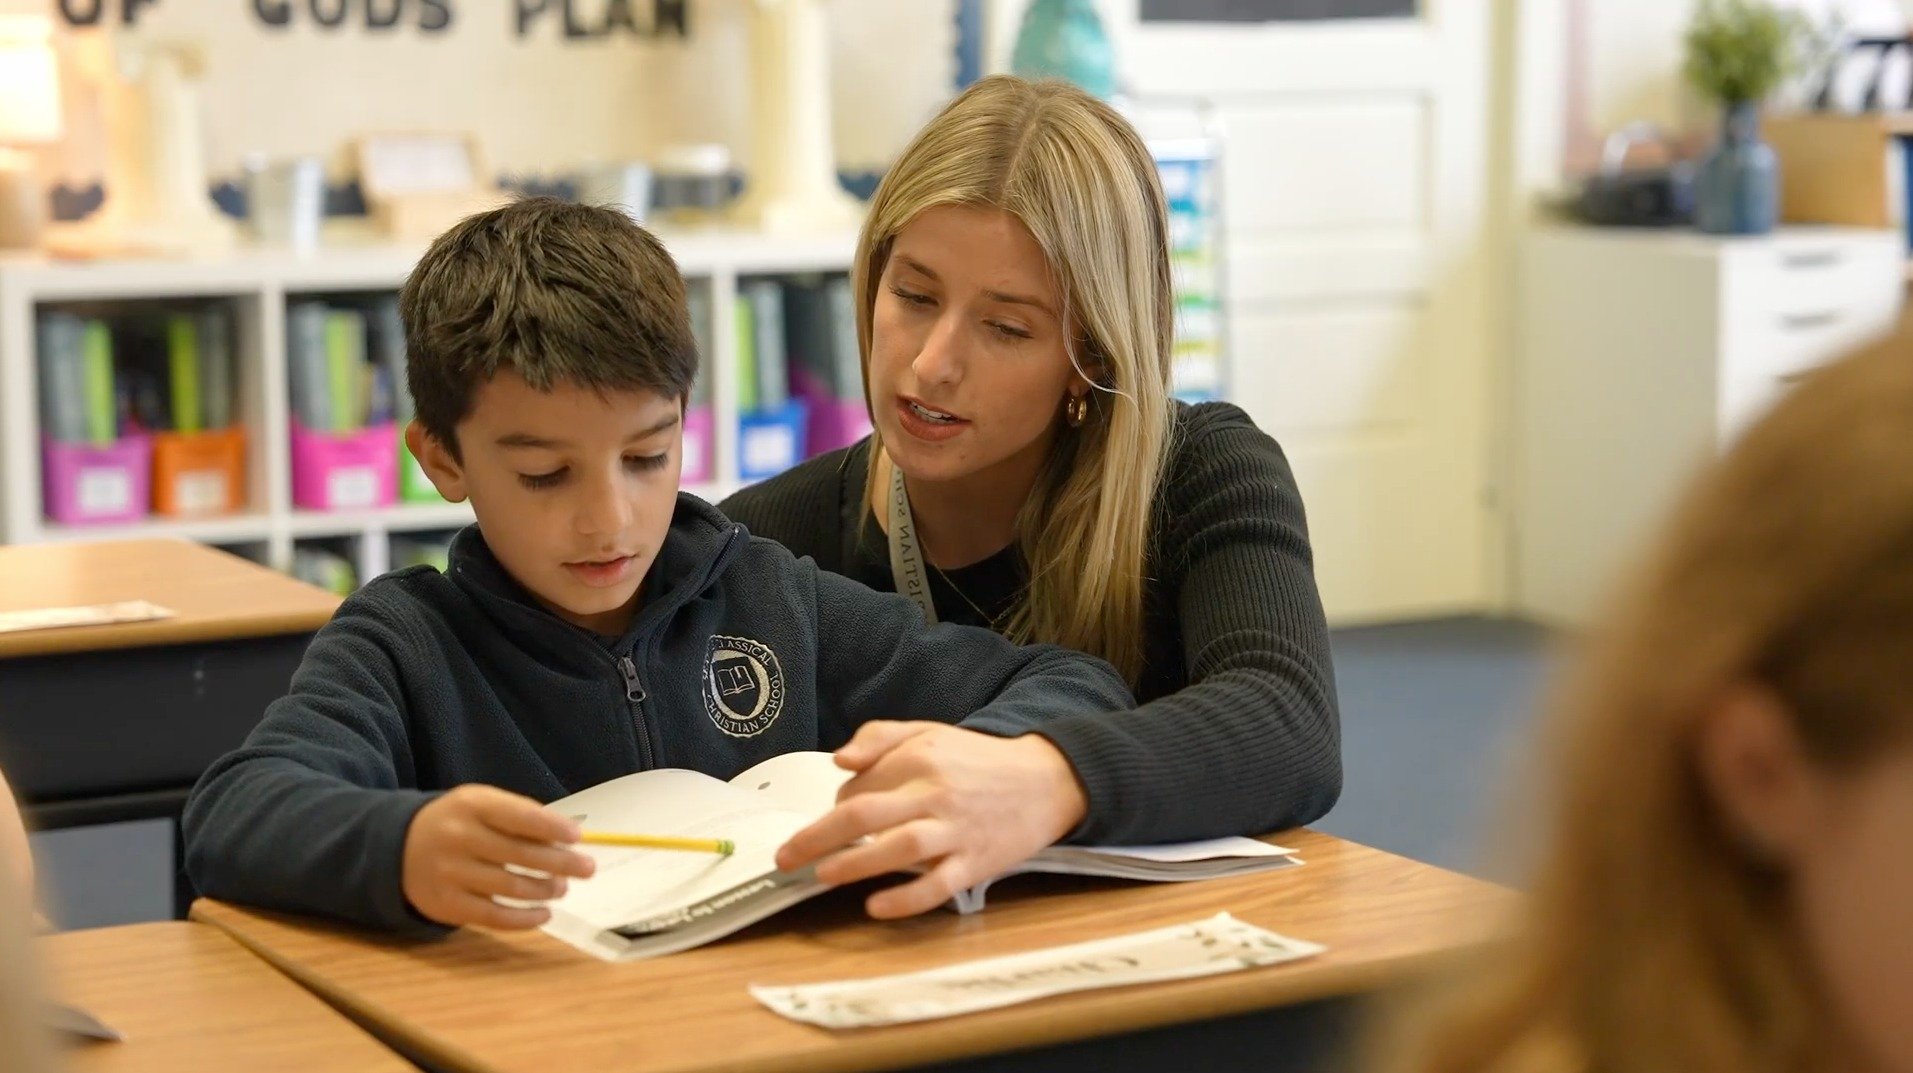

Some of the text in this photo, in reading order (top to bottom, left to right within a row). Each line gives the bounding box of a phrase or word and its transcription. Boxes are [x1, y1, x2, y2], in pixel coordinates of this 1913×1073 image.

[511, 0, 690, 39] PLAN
[718, 639, 772, 666] ASSICAL
[758, 670, 781, 725] SCHOOL
